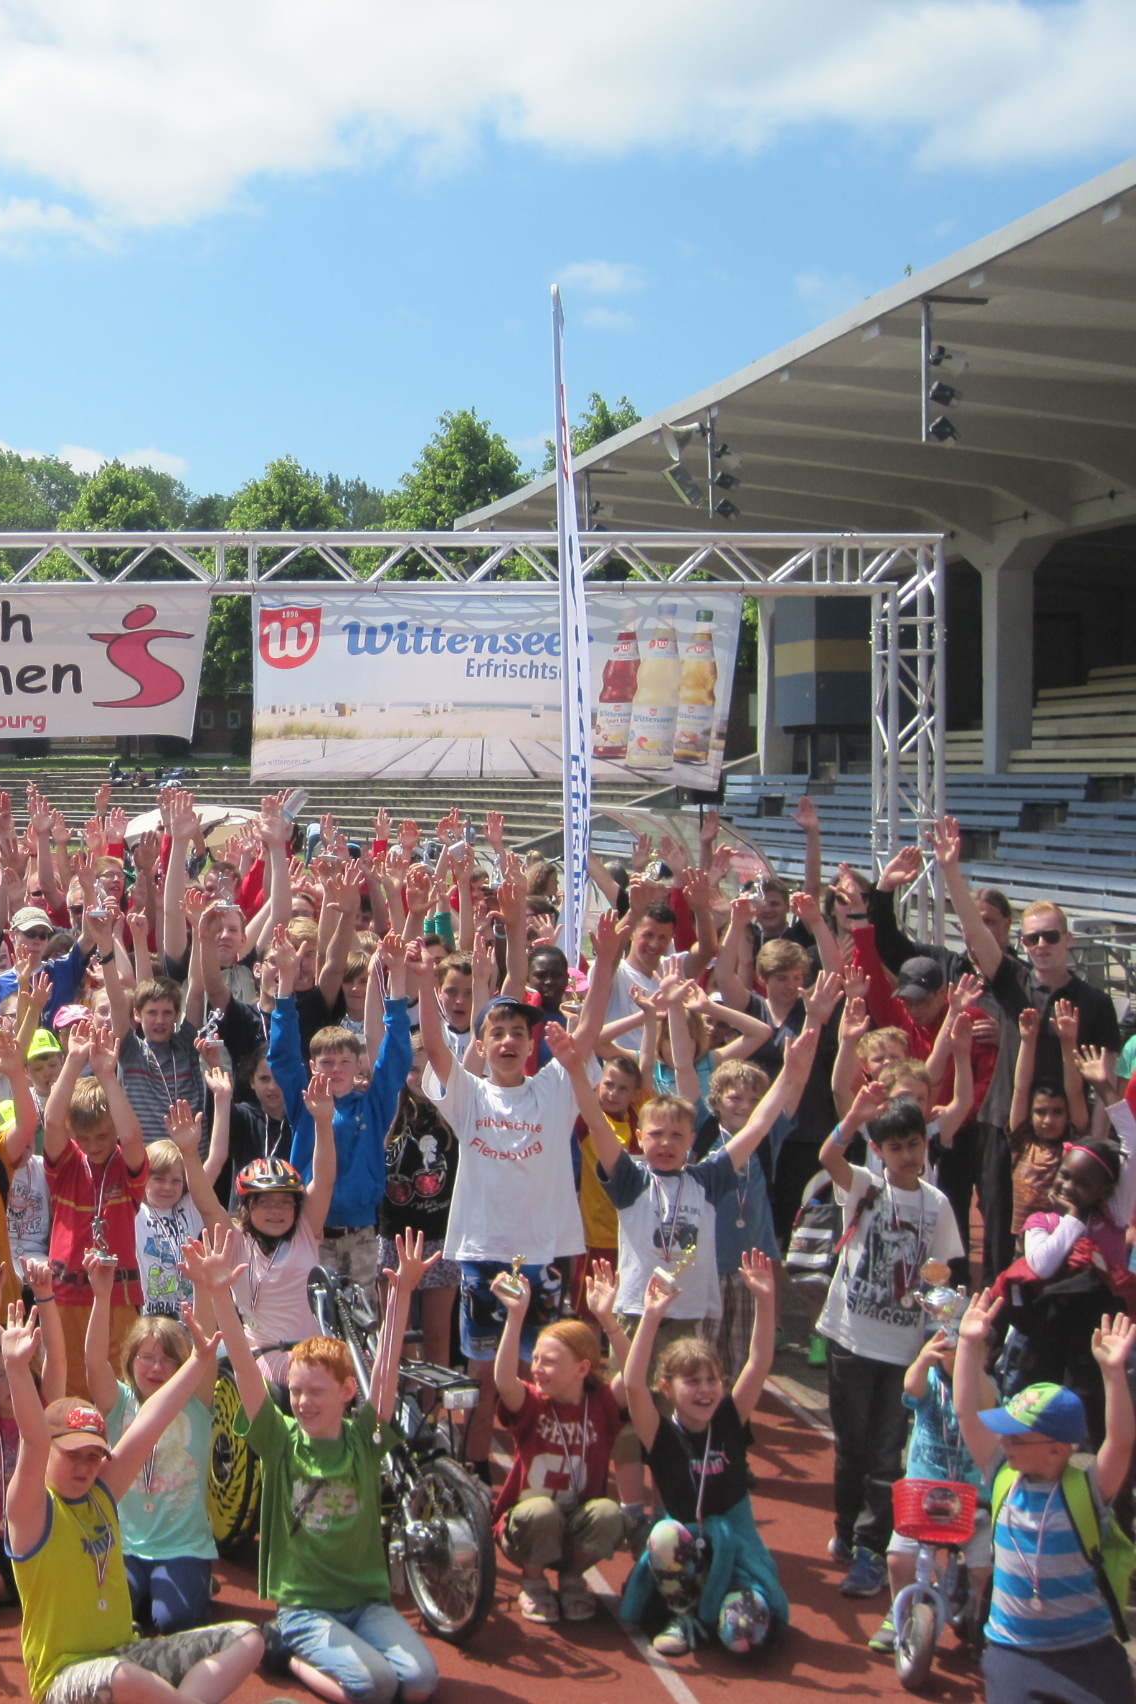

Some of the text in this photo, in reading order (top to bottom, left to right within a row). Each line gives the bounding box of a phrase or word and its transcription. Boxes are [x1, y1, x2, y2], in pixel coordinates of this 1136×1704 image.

[341, 621, 593, 656] Wittensee
[466, 658, 562, 680] Erfrischts
[469, 1136, 543, 1161] Flensburg
